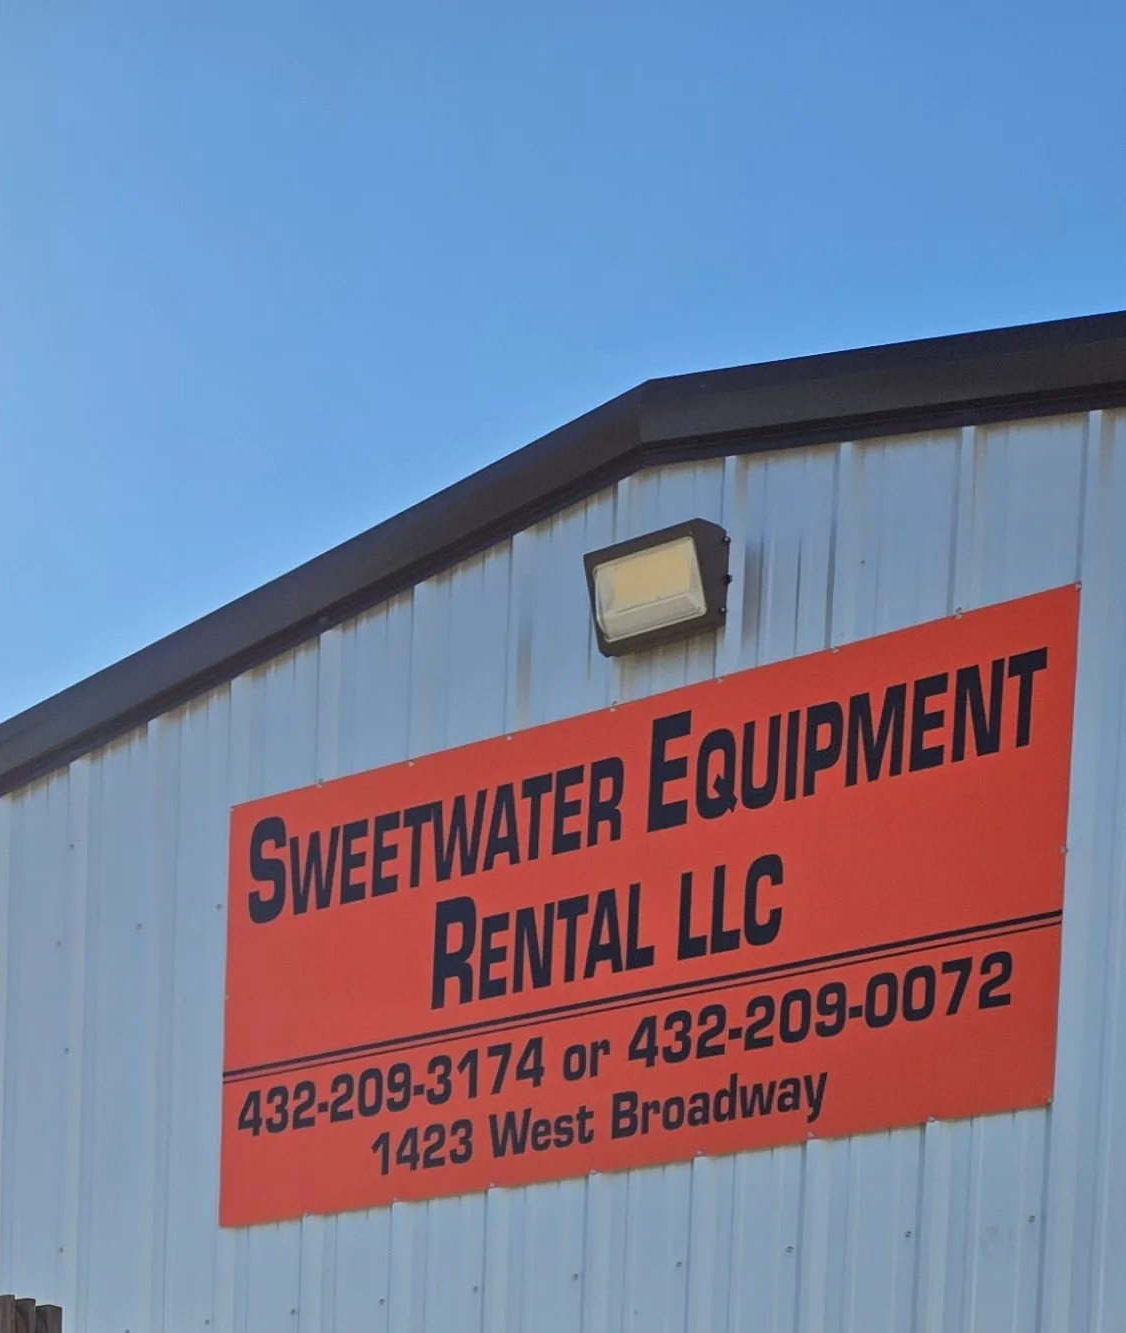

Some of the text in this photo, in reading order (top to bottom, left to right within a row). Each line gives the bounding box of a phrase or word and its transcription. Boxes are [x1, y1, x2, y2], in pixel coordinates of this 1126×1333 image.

[249, 647, 1048, 924] SWEETWATER EQUIPMENT
[432, 854, 784, 1010] RENTAL LLC
[238, 951, 1013, 1137] 432-209-3174 or 432-209-0072
[372, 1072, 828, 1175] 1423 West Broadway
